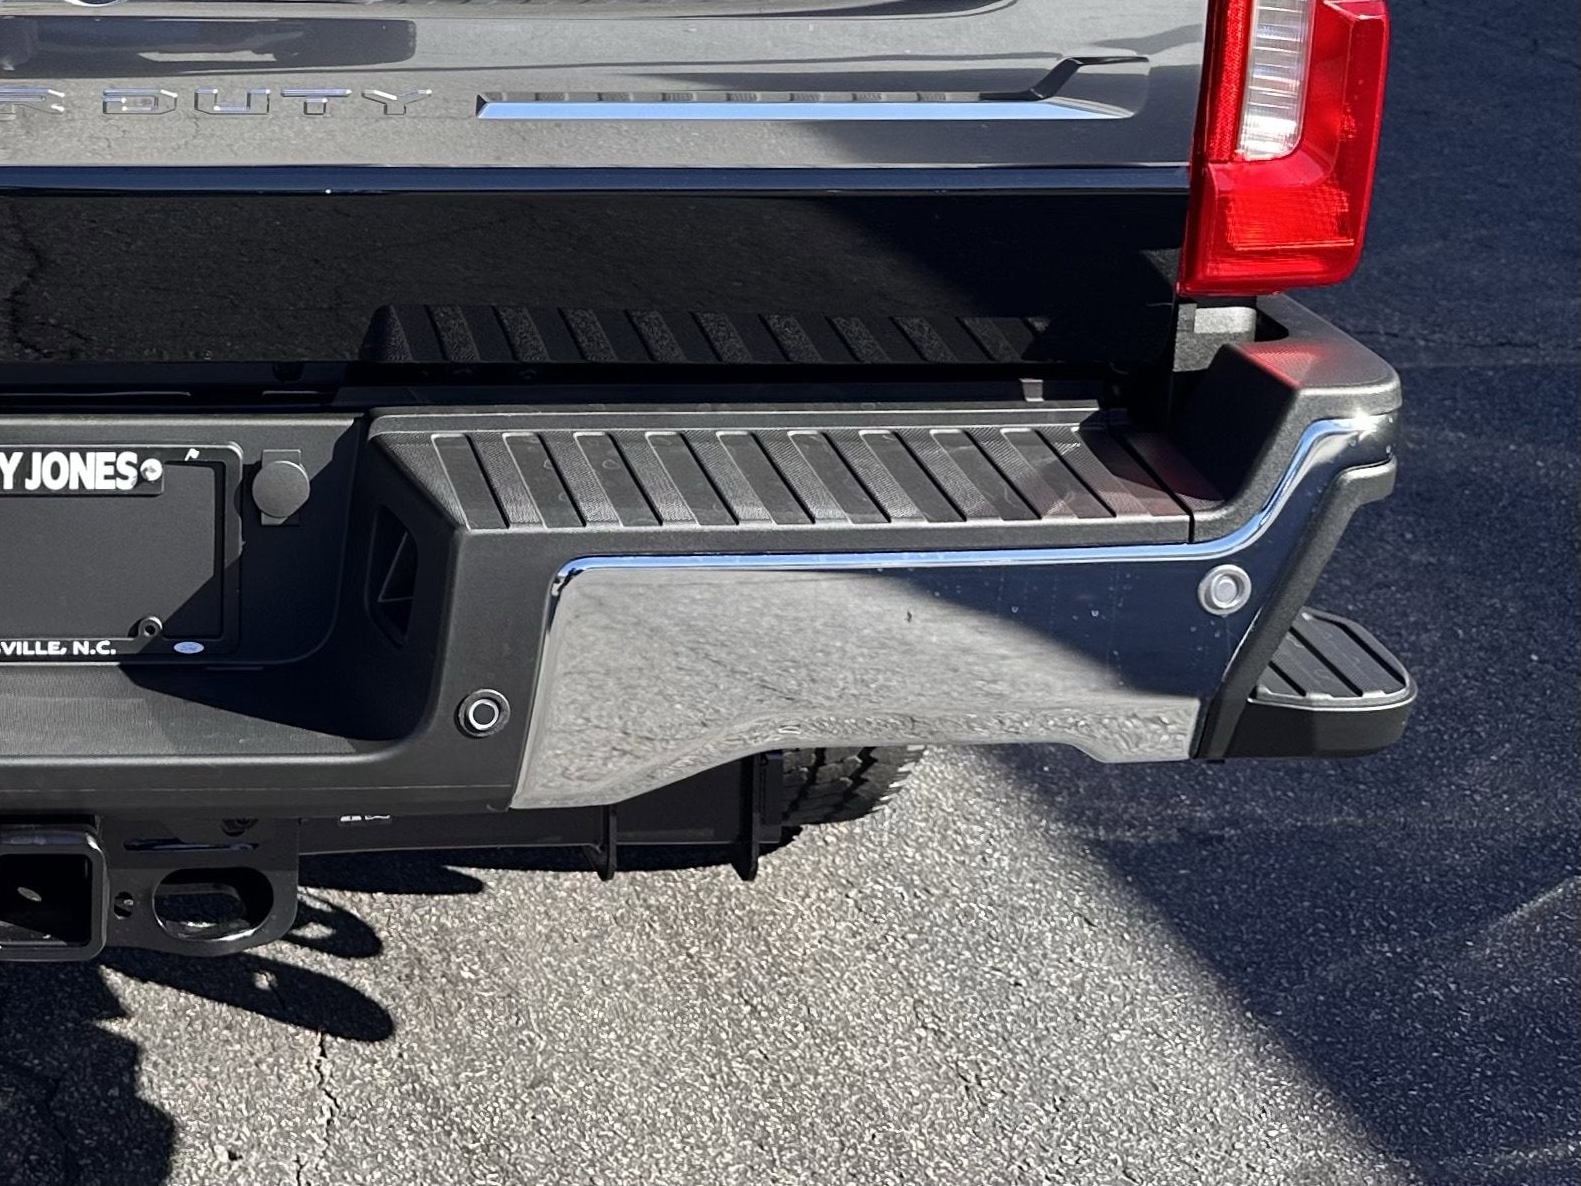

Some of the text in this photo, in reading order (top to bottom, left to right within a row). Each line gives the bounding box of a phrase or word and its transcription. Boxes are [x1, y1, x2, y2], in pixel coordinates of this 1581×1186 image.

[103, 87, 433, 116] DUTY
[24, 452, 139, 491] JONES
[72, 640, 118, 656] N.C.
